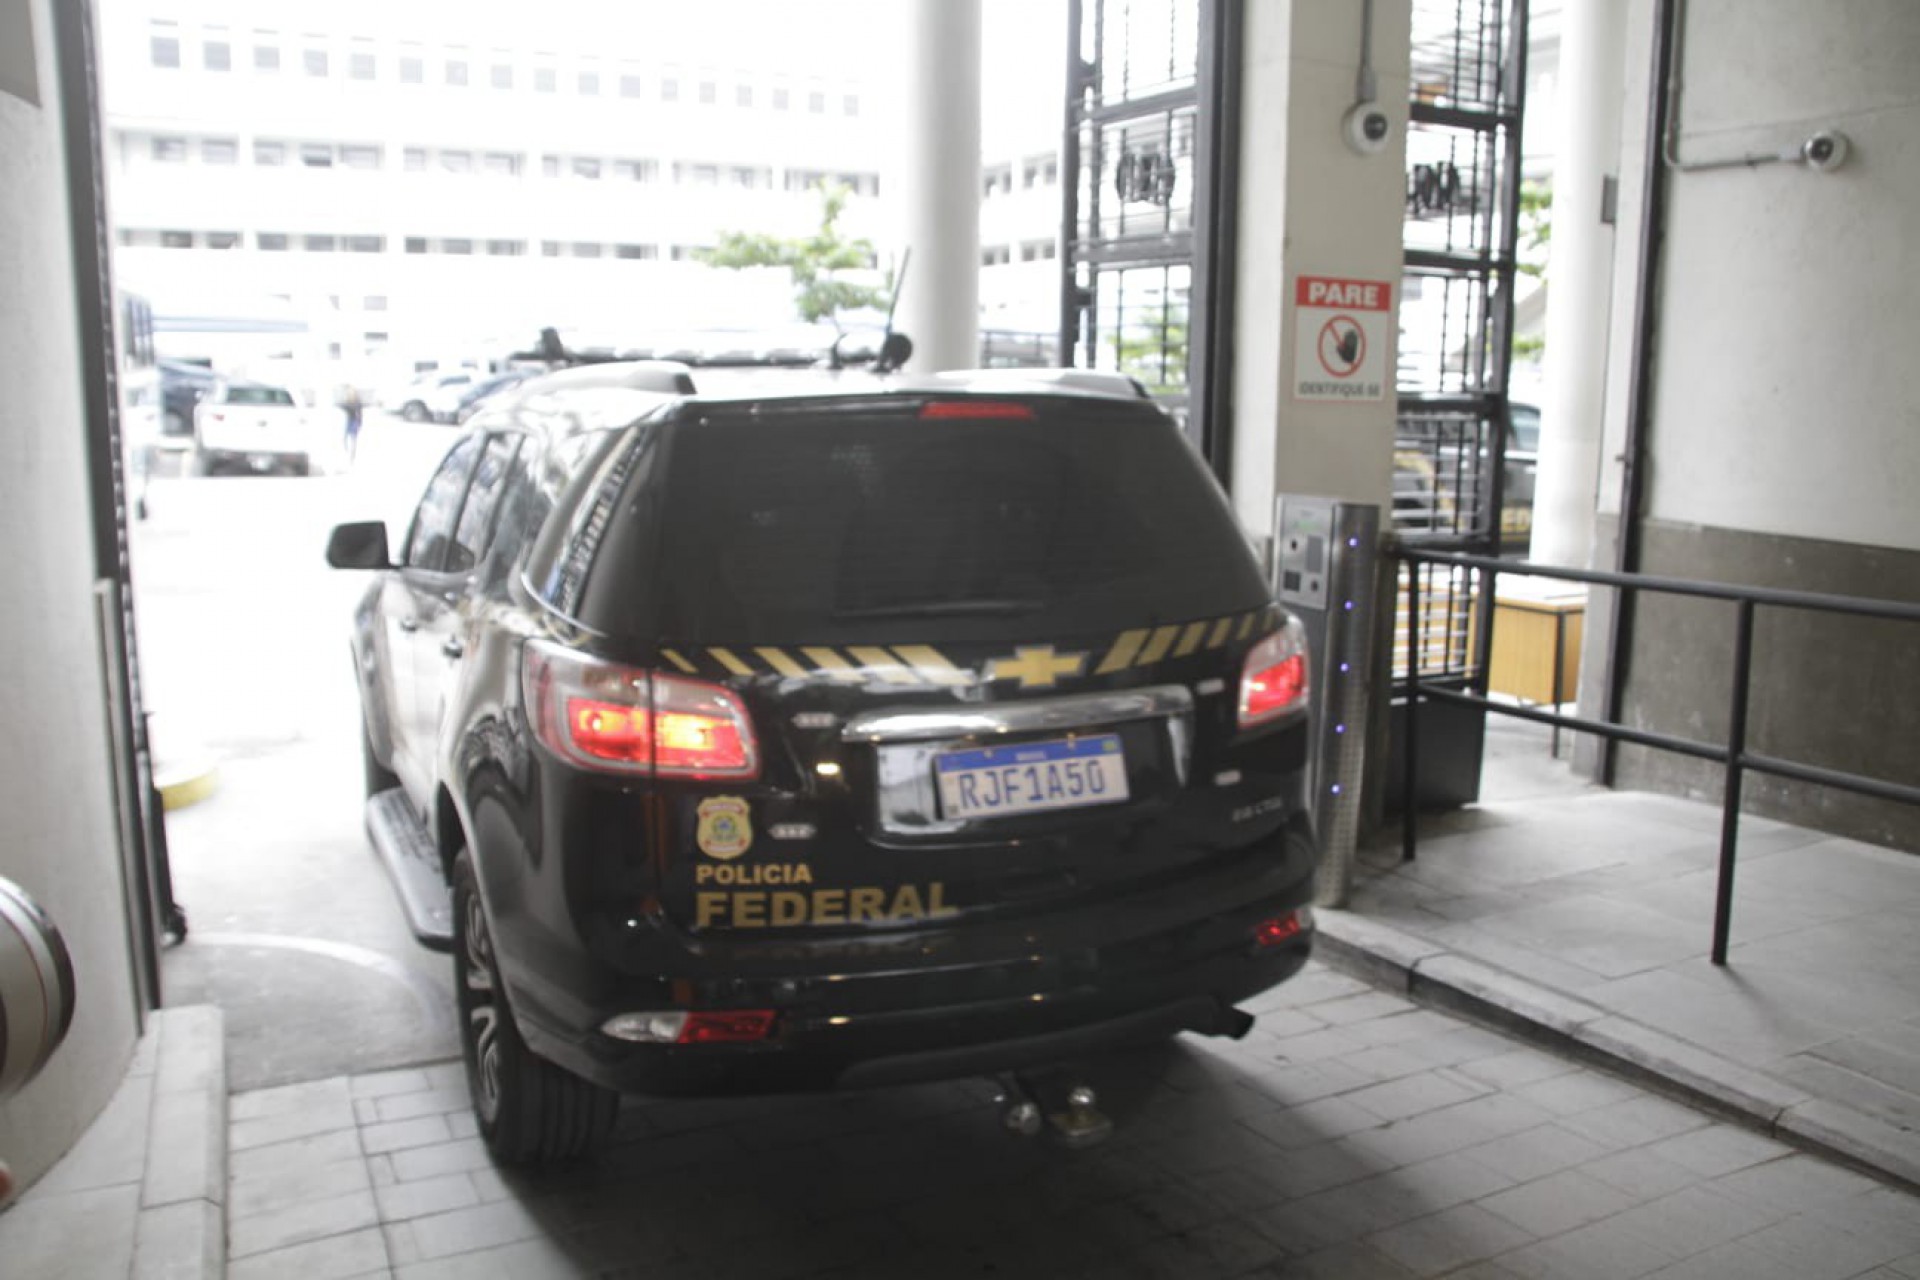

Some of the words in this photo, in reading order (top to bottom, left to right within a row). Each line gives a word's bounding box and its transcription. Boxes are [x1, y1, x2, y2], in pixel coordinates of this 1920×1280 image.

[1308, 281, 1379, 307] PARE
[958, 760, 1107, 811] RJF1A50
[696, 864, 813, 884] POLICIA
[696, 883, 957, 928] FEDERAL
